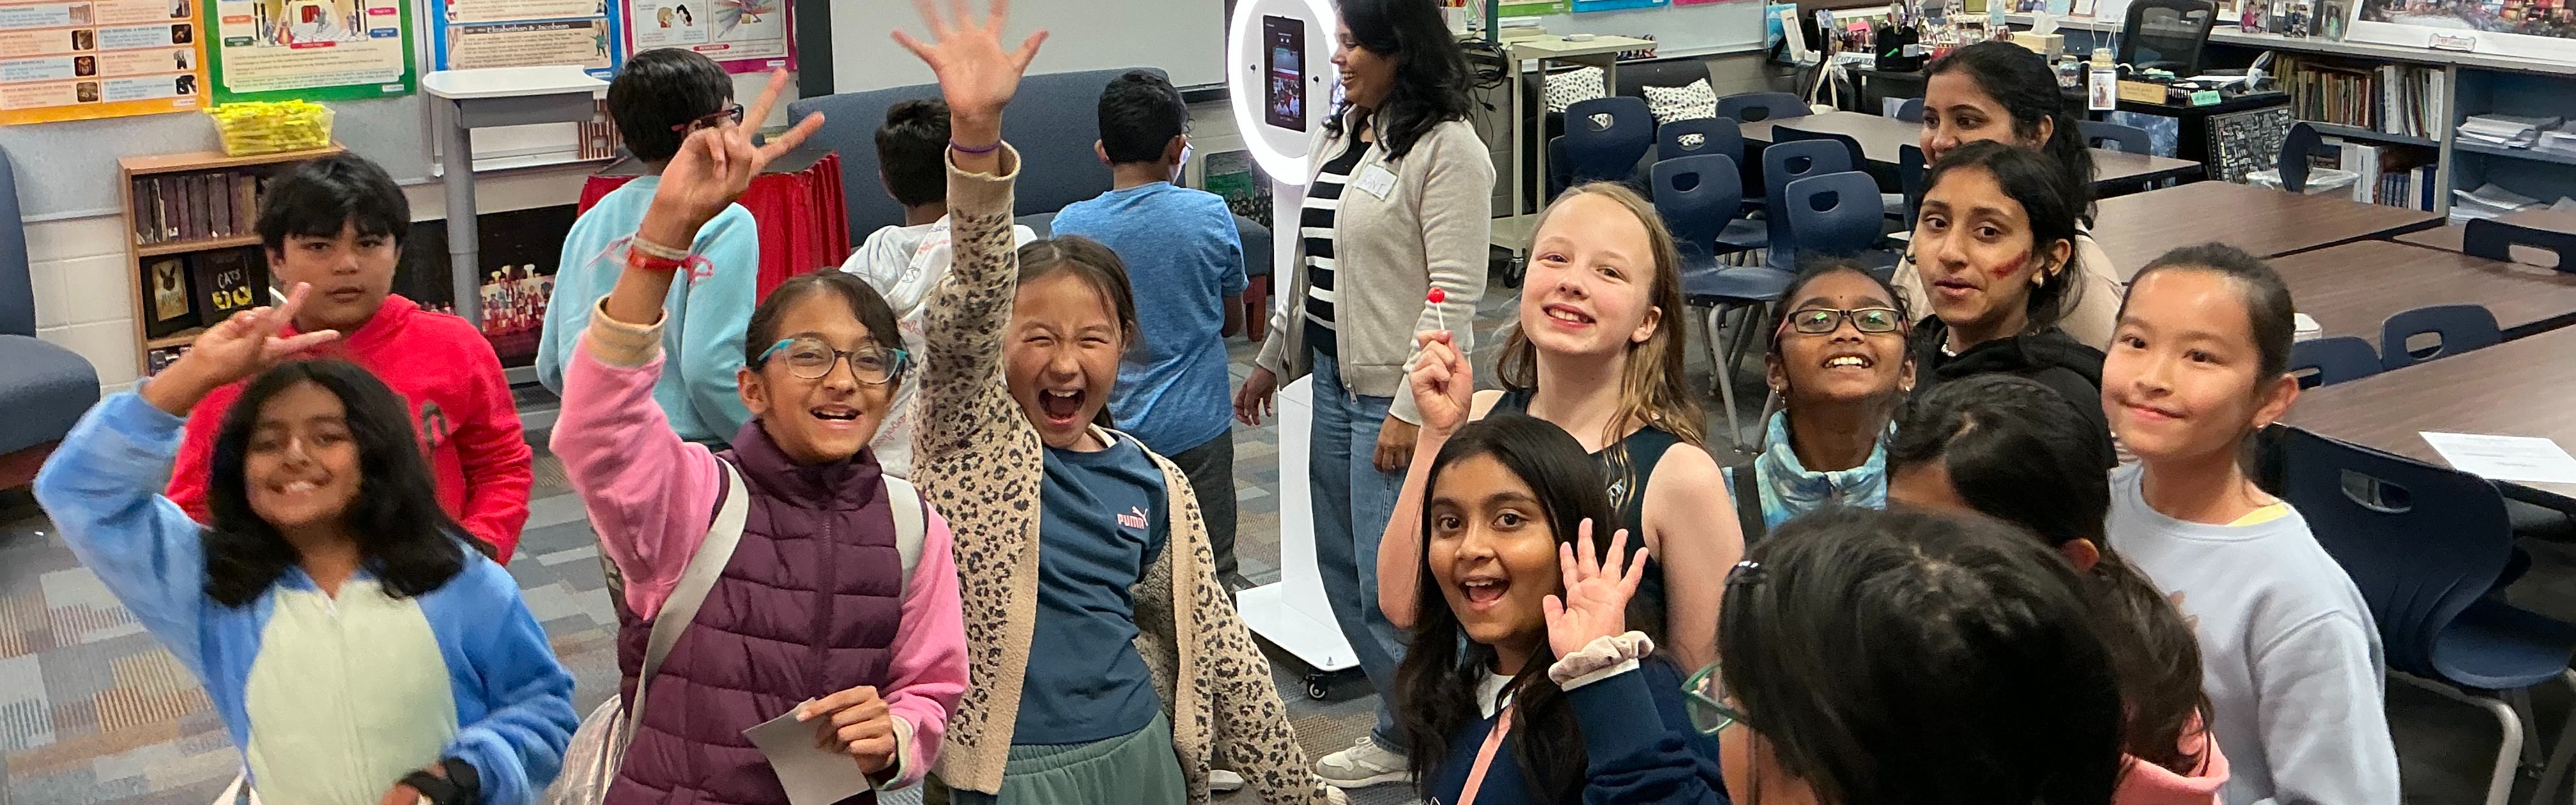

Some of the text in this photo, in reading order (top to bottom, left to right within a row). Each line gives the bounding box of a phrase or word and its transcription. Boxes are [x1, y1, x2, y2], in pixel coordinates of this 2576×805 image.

[487, 24, 527, 33] Elizabethan
[537, 22, 569, 31] Jacobean
[218, 268, 241, 289] CATS
[1117, 513, 1144, 530] PUMA
